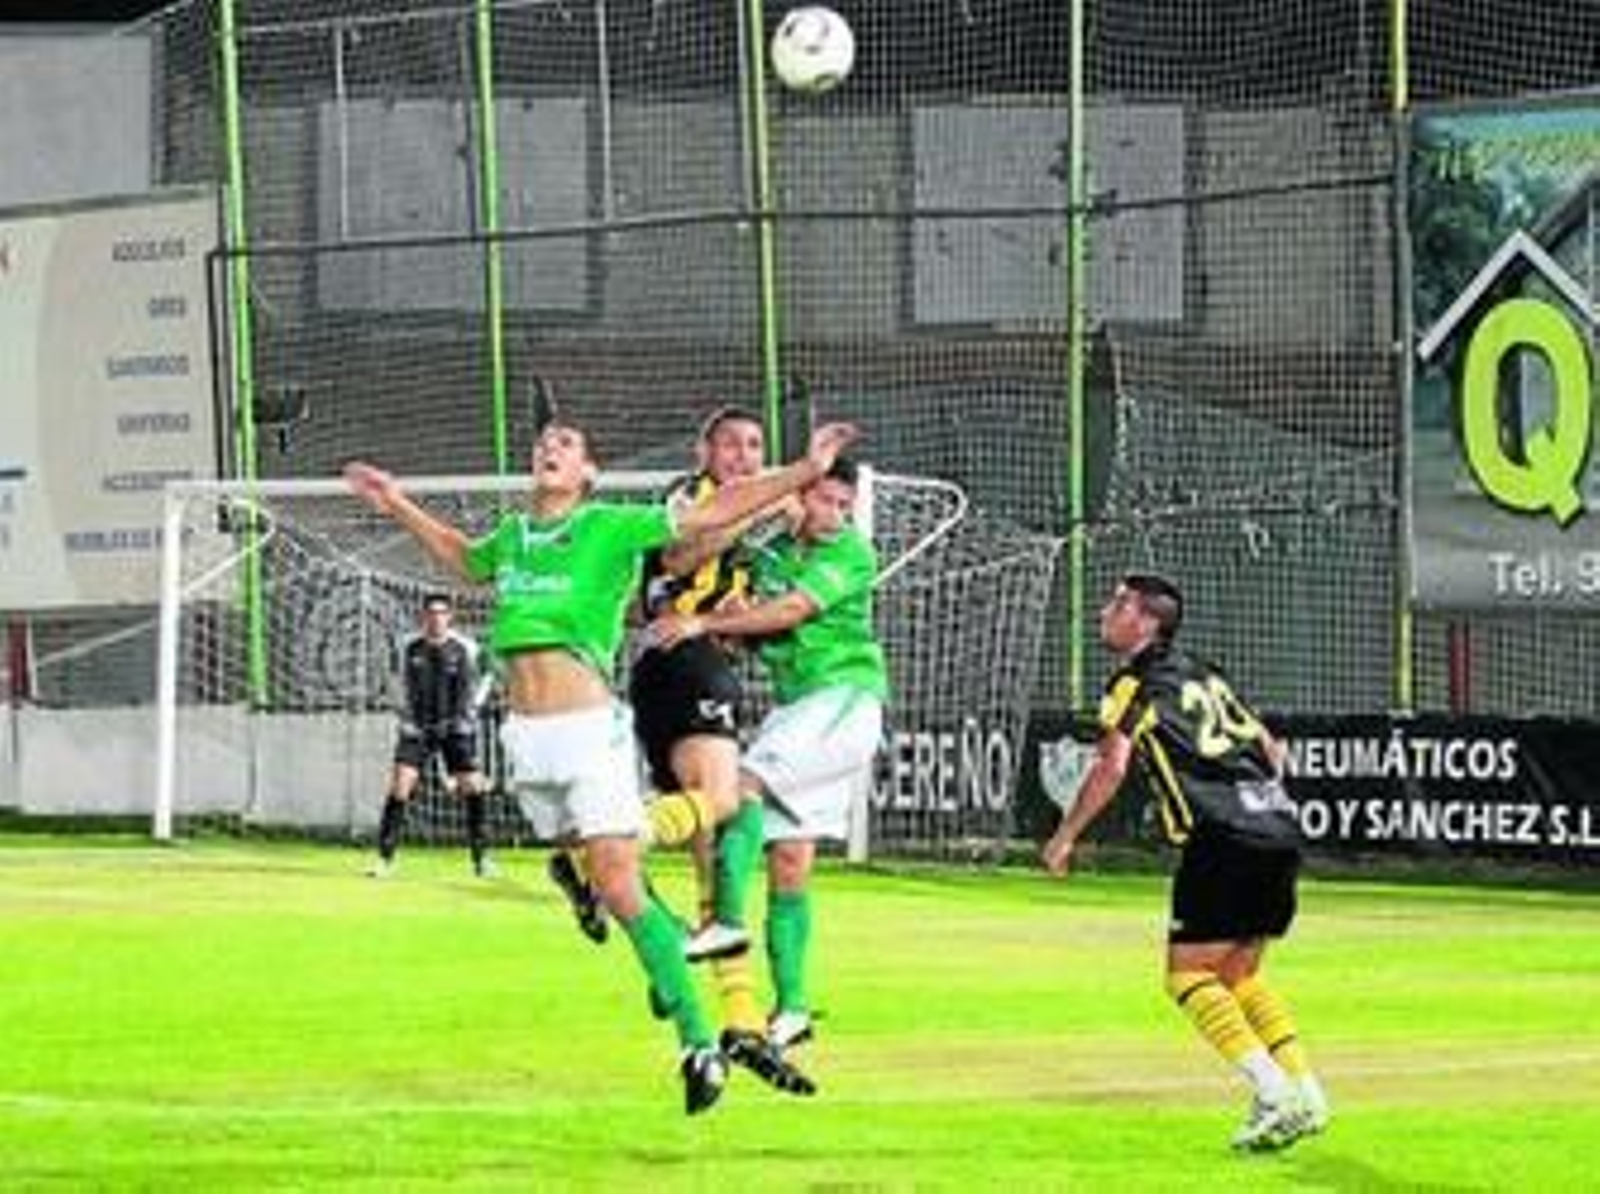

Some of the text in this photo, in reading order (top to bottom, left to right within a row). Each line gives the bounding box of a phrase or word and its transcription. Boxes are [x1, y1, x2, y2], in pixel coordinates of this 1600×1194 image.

[1461, 297, 1592, 525] Q
[1181, 674, 1262, 758] 20
[1291, 800, 1331, 839] O
[1336, 800, 1361, 840] Y
[1365, 799, 1542, 845] SANCHEZ
